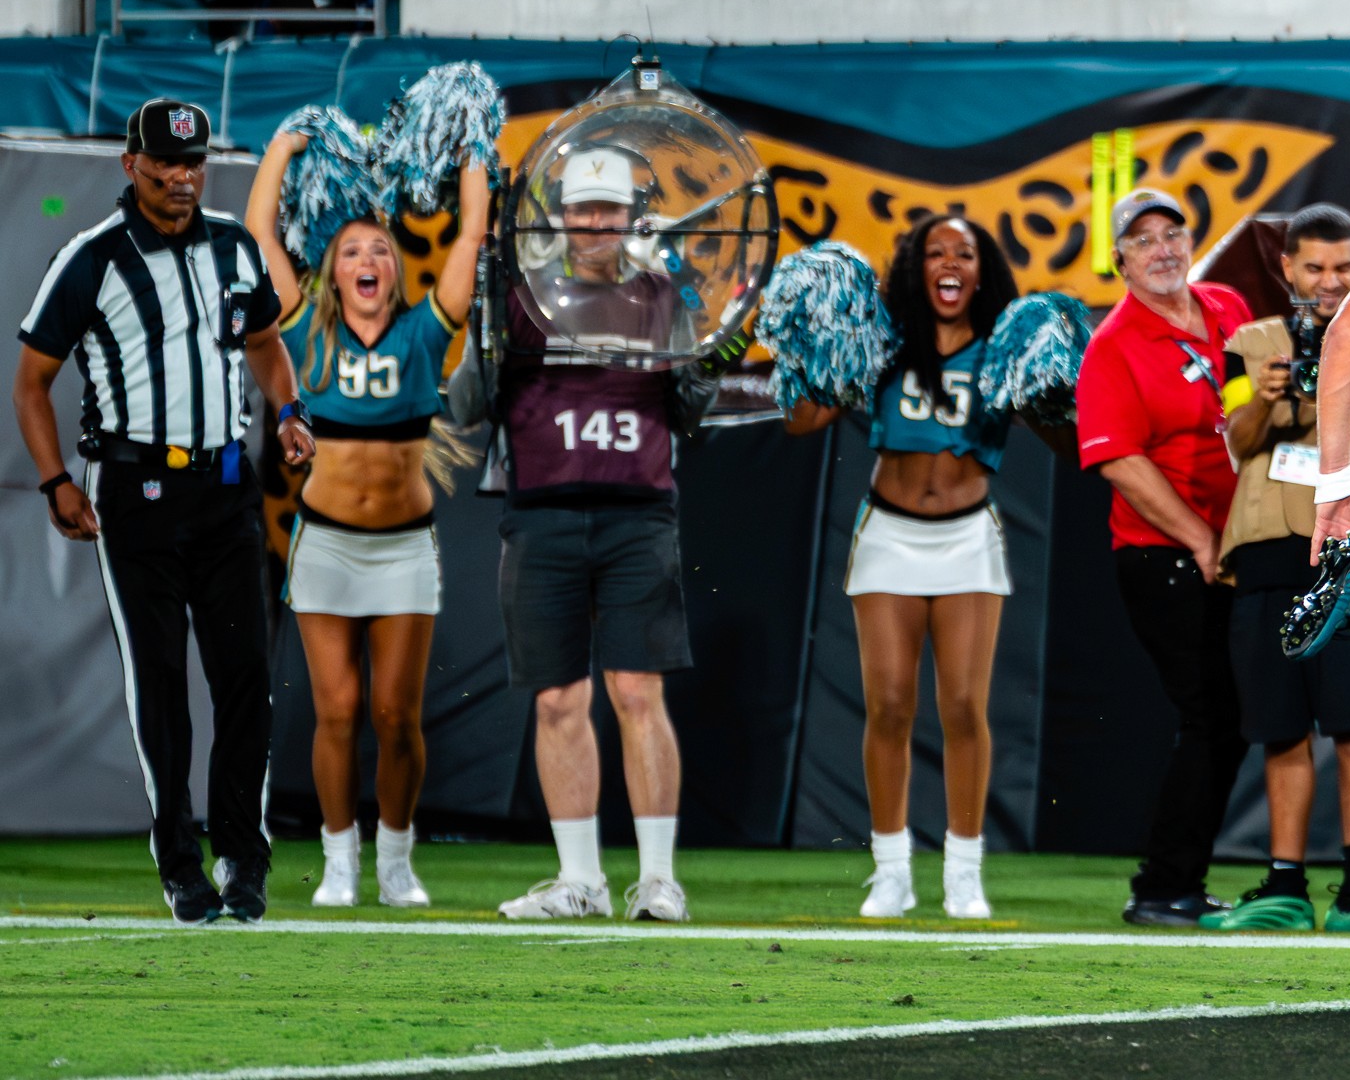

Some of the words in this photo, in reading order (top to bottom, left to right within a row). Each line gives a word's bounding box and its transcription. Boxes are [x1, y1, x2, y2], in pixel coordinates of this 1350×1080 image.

[337, 352, 401, 400] 95
[899, 370, 973, 428] 95
[554, 409, 642, 453] 143
